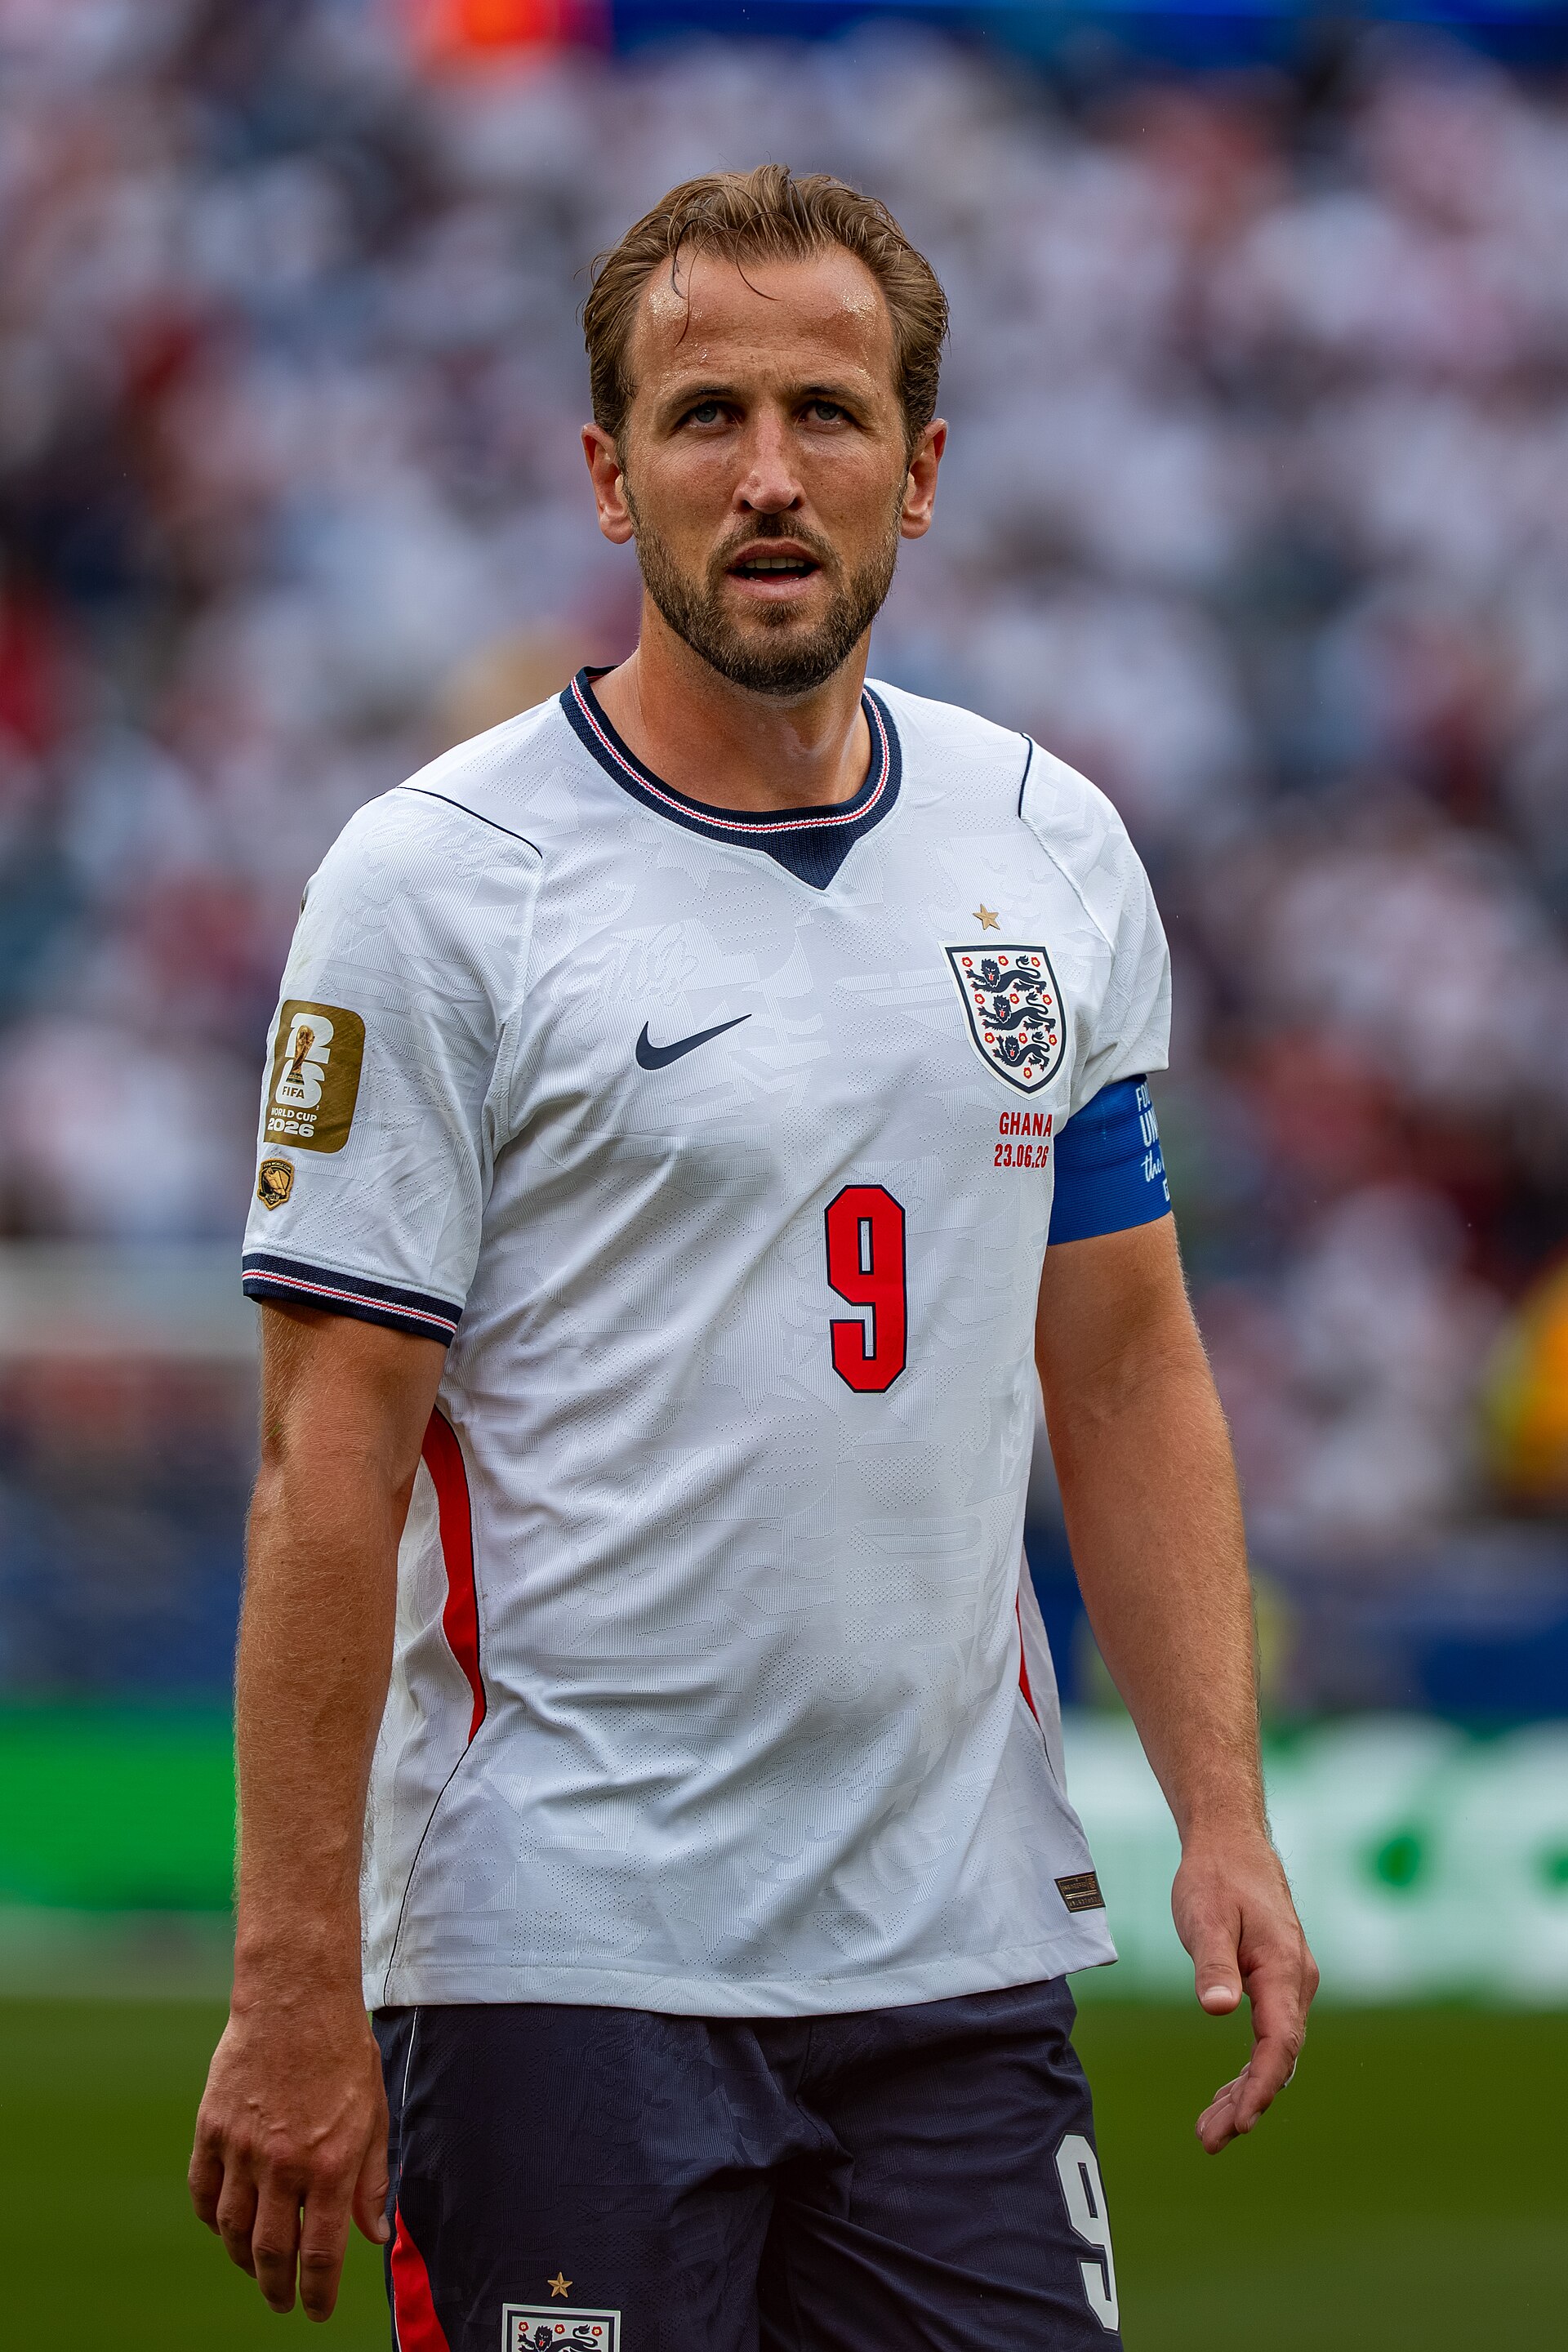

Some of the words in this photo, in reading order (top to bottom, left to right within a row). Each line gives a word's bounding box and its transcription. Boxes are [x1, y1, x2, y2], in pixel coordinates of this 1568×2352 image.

[282, 1086, 305, 1099] FIFA
[267, 1117, 315, 1138] 2026
[271, 1107, 295, 1119] WORLD
[296, 1111, 318, 1123] CUP
[999, 1111, 1053, 1138] GHANA
[994, 1143, 1049, 1169] 23.06.26
[824, 1184, 907, 1393] 9
[1054, 2132, 1120, 2333] 9
